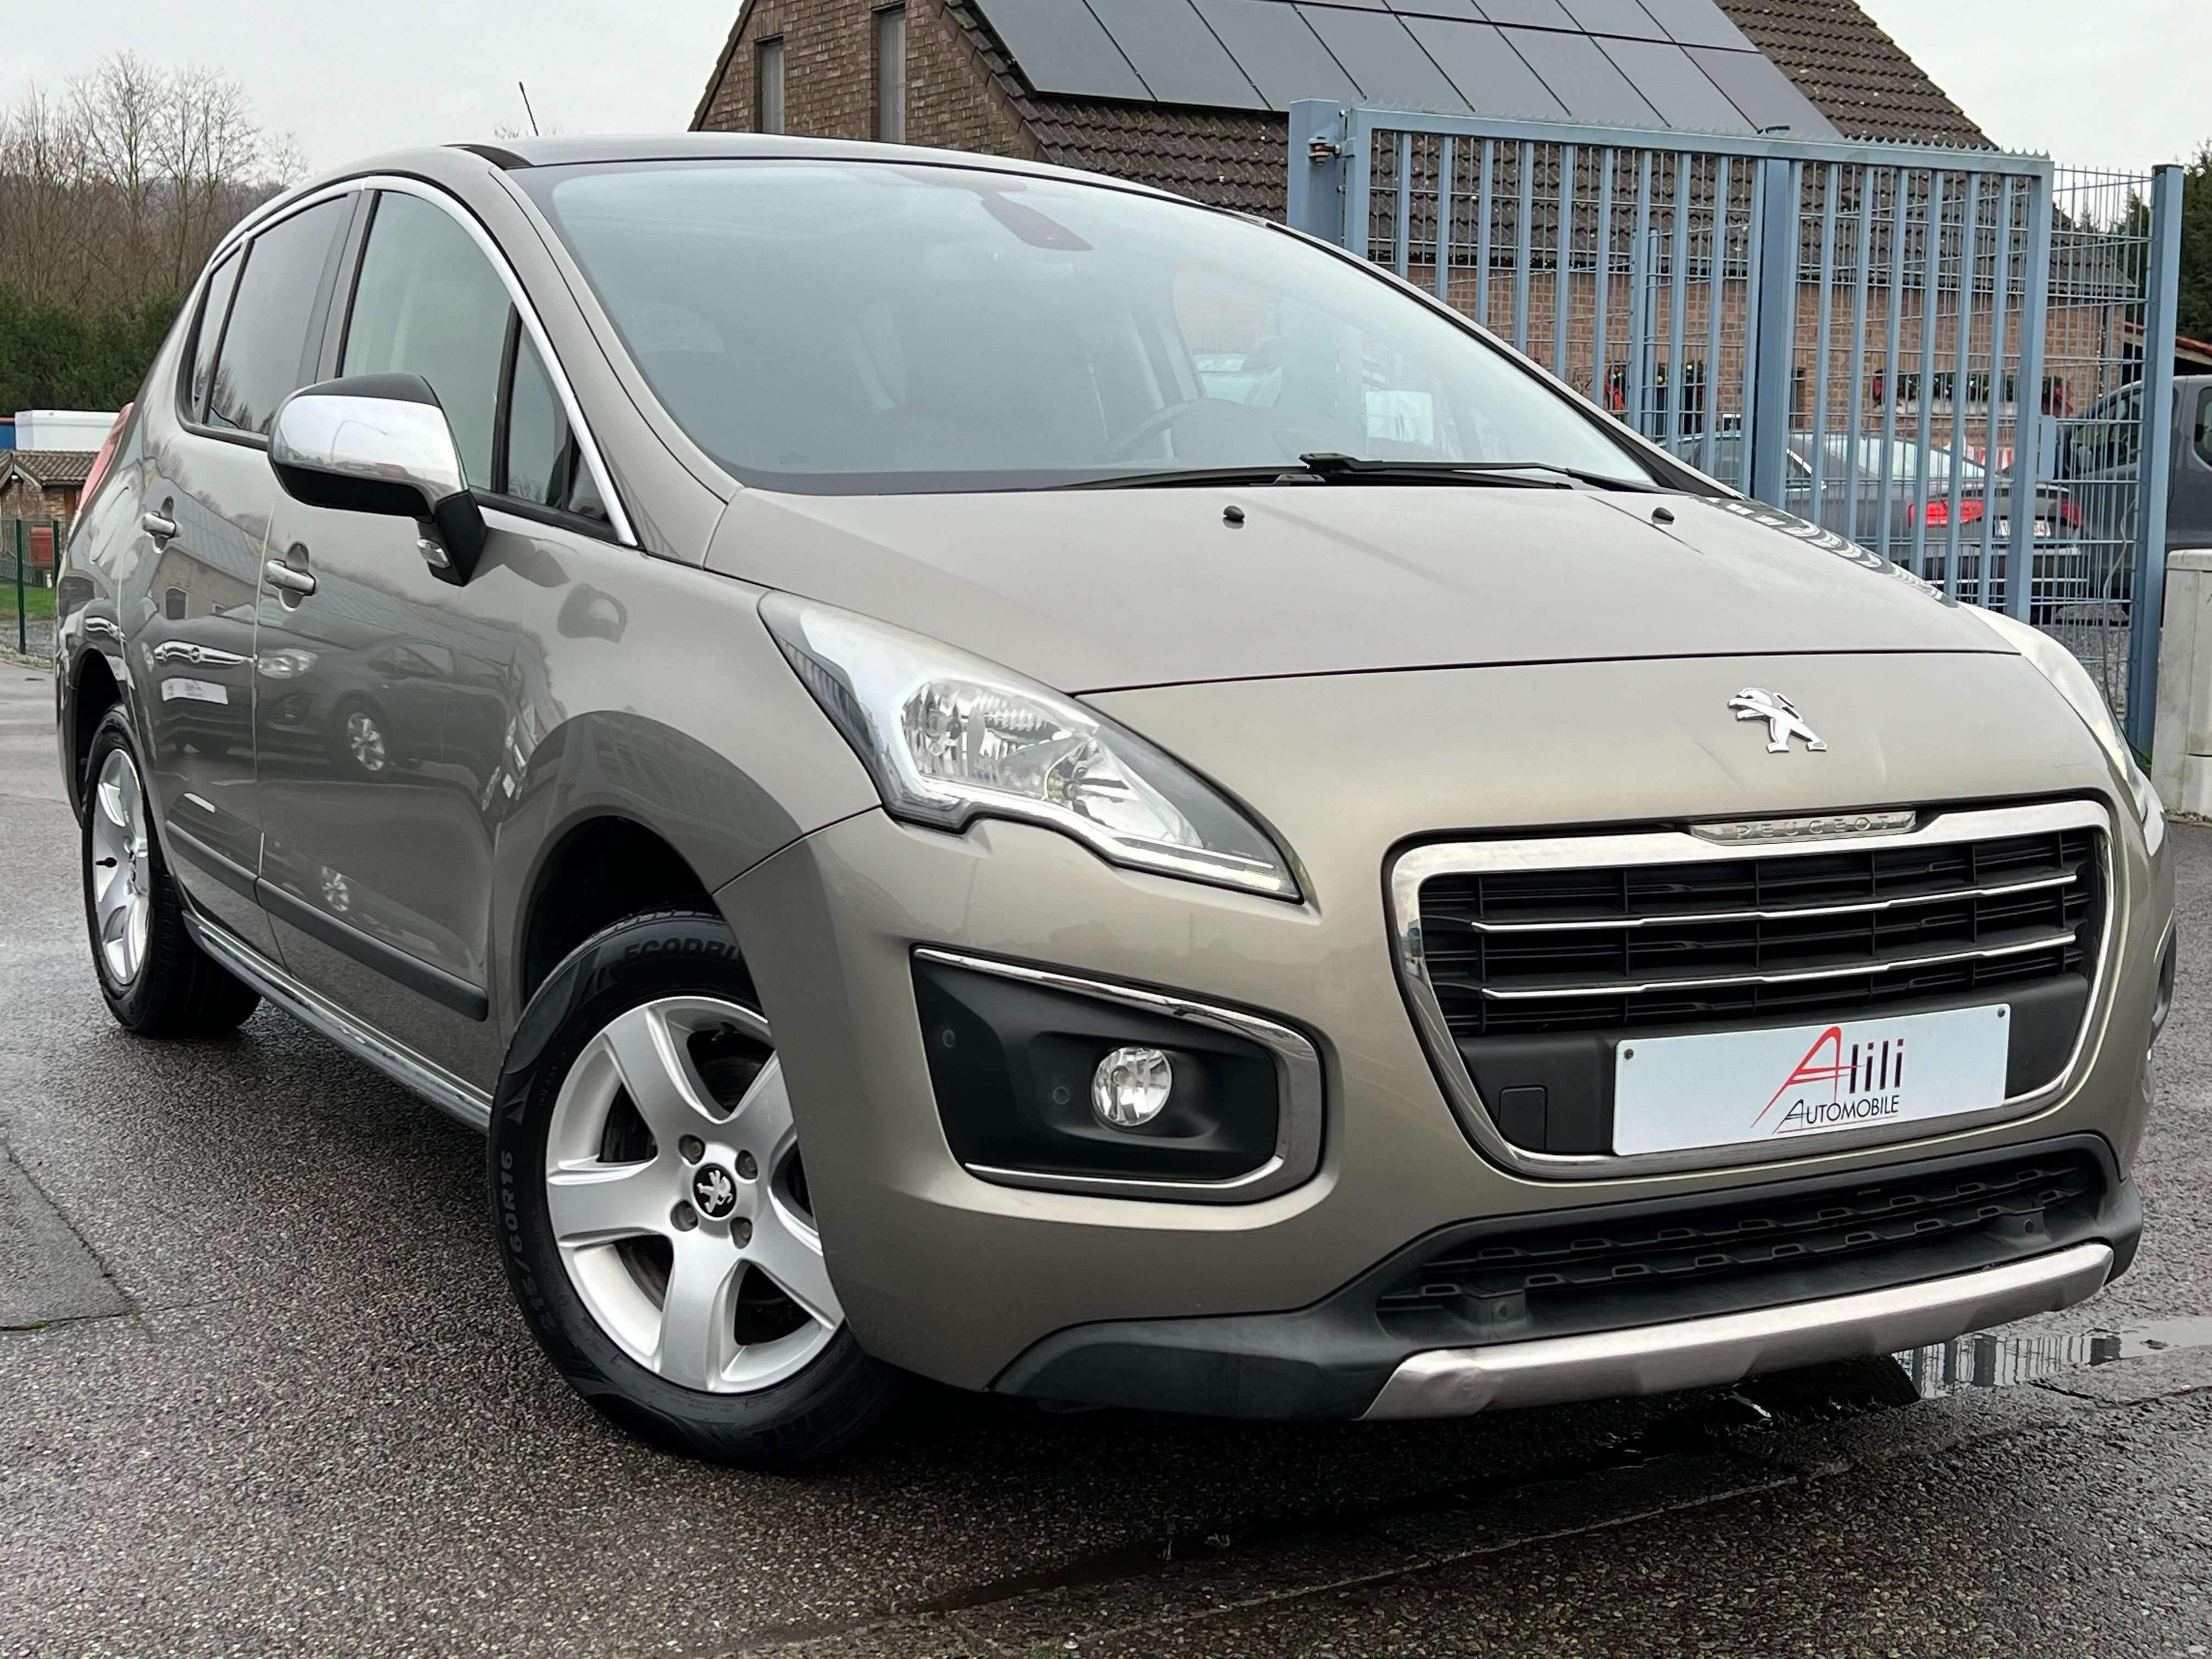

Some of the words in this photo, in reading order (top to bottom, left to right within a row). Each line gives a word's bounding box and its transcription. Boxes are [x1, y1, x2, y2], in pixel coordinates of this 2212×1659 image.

[1735, 815, 1889, 838] PEUGEOT
[1750, 1026, 1904, 1128] Alili
[1772, 1095, 1899, 1135] AUTOMOBILE
